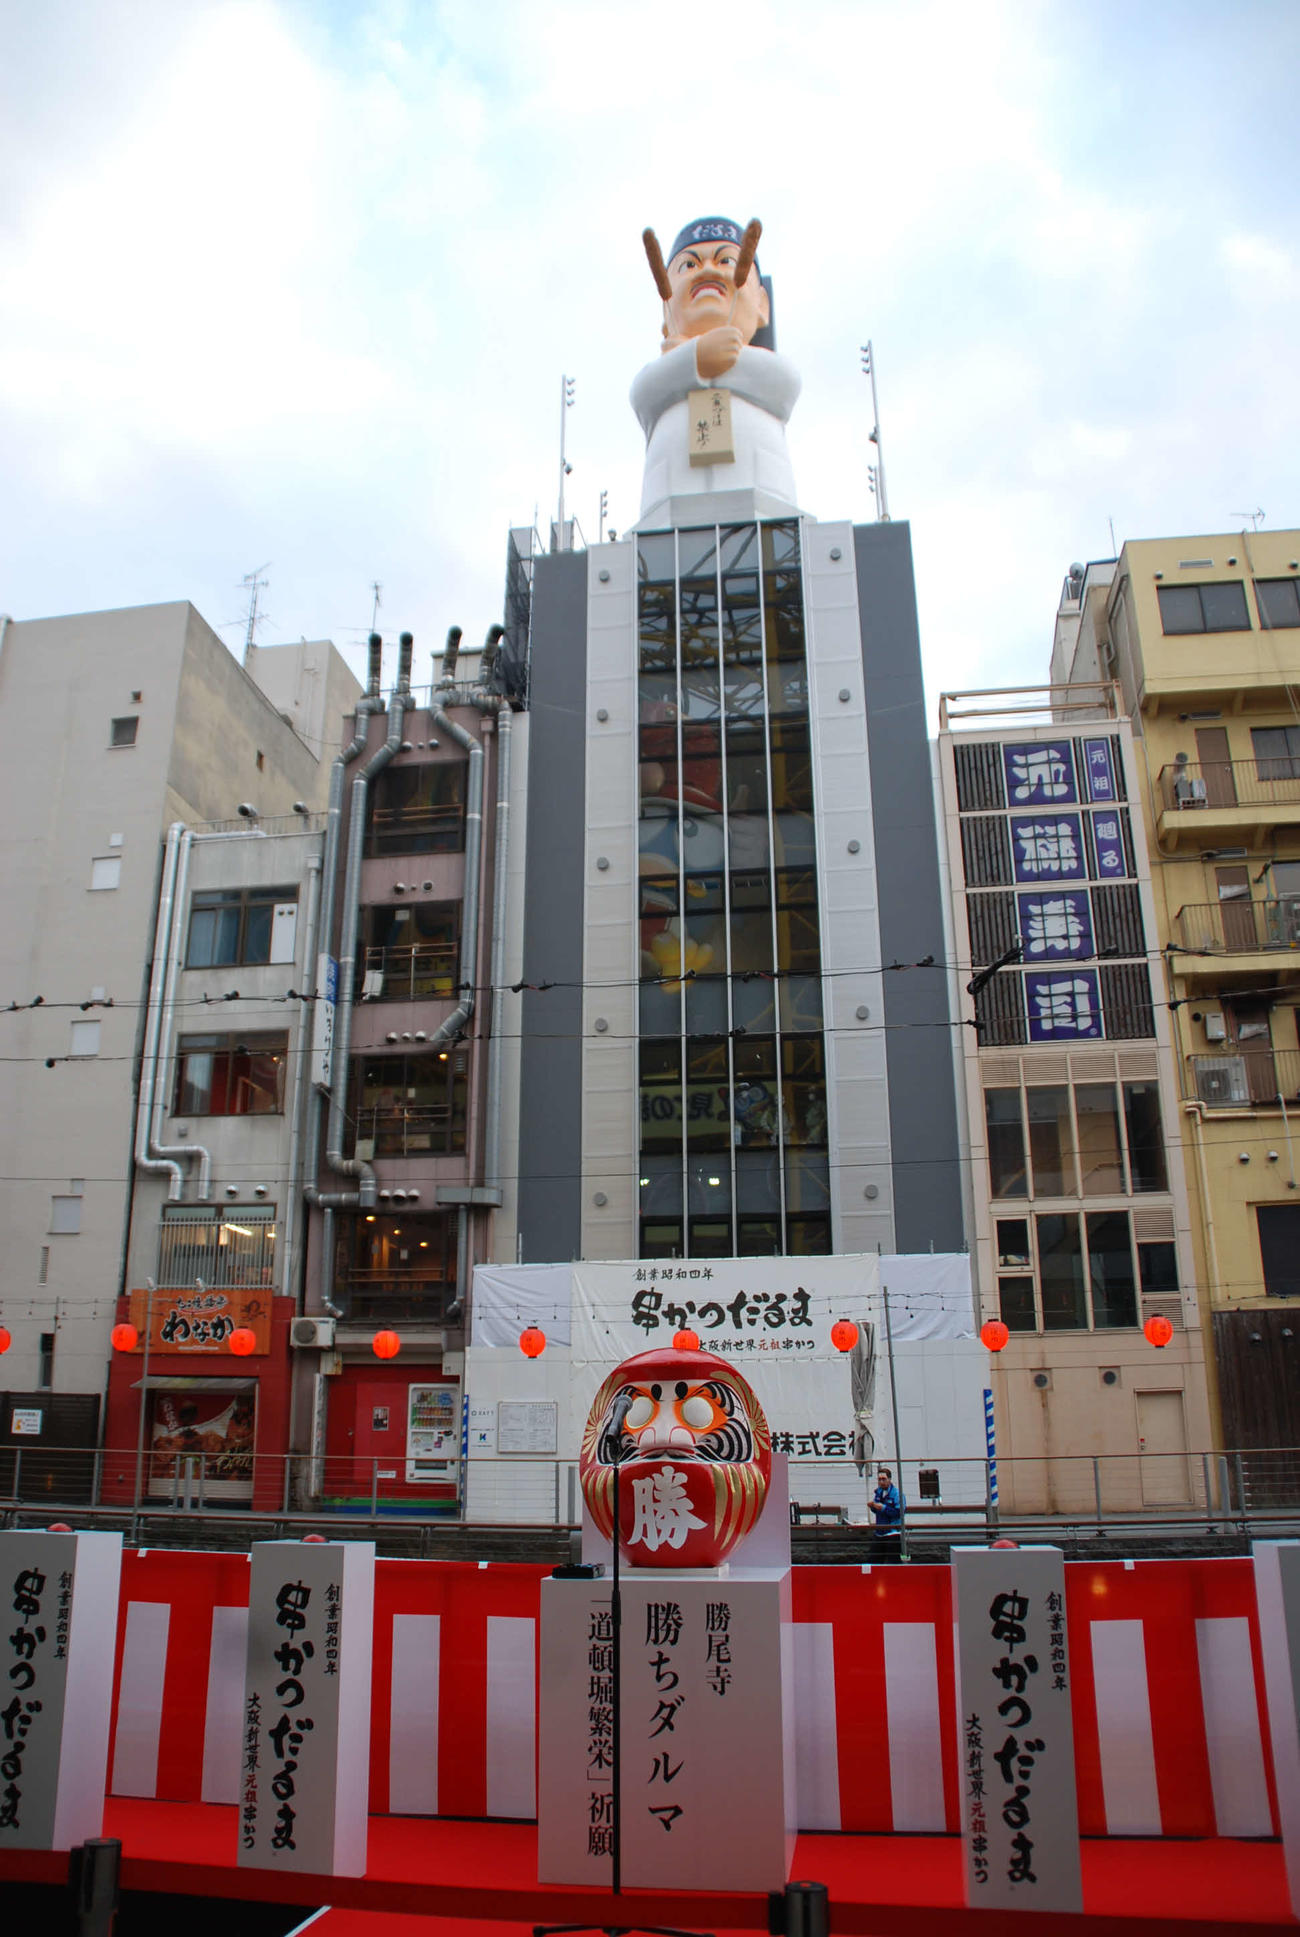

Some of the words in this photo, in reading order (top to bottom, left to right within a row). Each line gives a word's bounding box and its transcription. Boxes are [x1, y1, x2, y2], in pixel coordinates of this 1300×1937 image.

[1090, 749, 1109, 791] 元祖
[632, 1286, 813, 1336] 串かつだるま
[633, 1267, 714, 1281] 創業昭和四年
[161, 1310, 234, 1343] わなか
[699, 1337, 815, 1353] 大阪新世界元祖串かつ
[771, 1430, 855, 1457] 株式会
[627, 1465, 708, 1552] 勝
[54, 1570, 72, 1660] 創業昭和四年
[324, 1583, 340, 1675] 創業昭和四年
[704, 1601, 732, 1696] 勝尾寺
[1044, 1591, 1067, 1691] 創業昭和四年
[0, 1567, 47, 1829] 串かつだるま
[269, 1580, 314, 1851] 串かつだるま
[645, 1601, 685, 1832] 勝ちダルマ
[989, 1588, 1046, 1884] 串かつだるま
[243, 1692, 262, 1849] 大阪新世界元祖串かつ
[965, 1714, 989, 1883] 大阪新世界元祖串かつ
